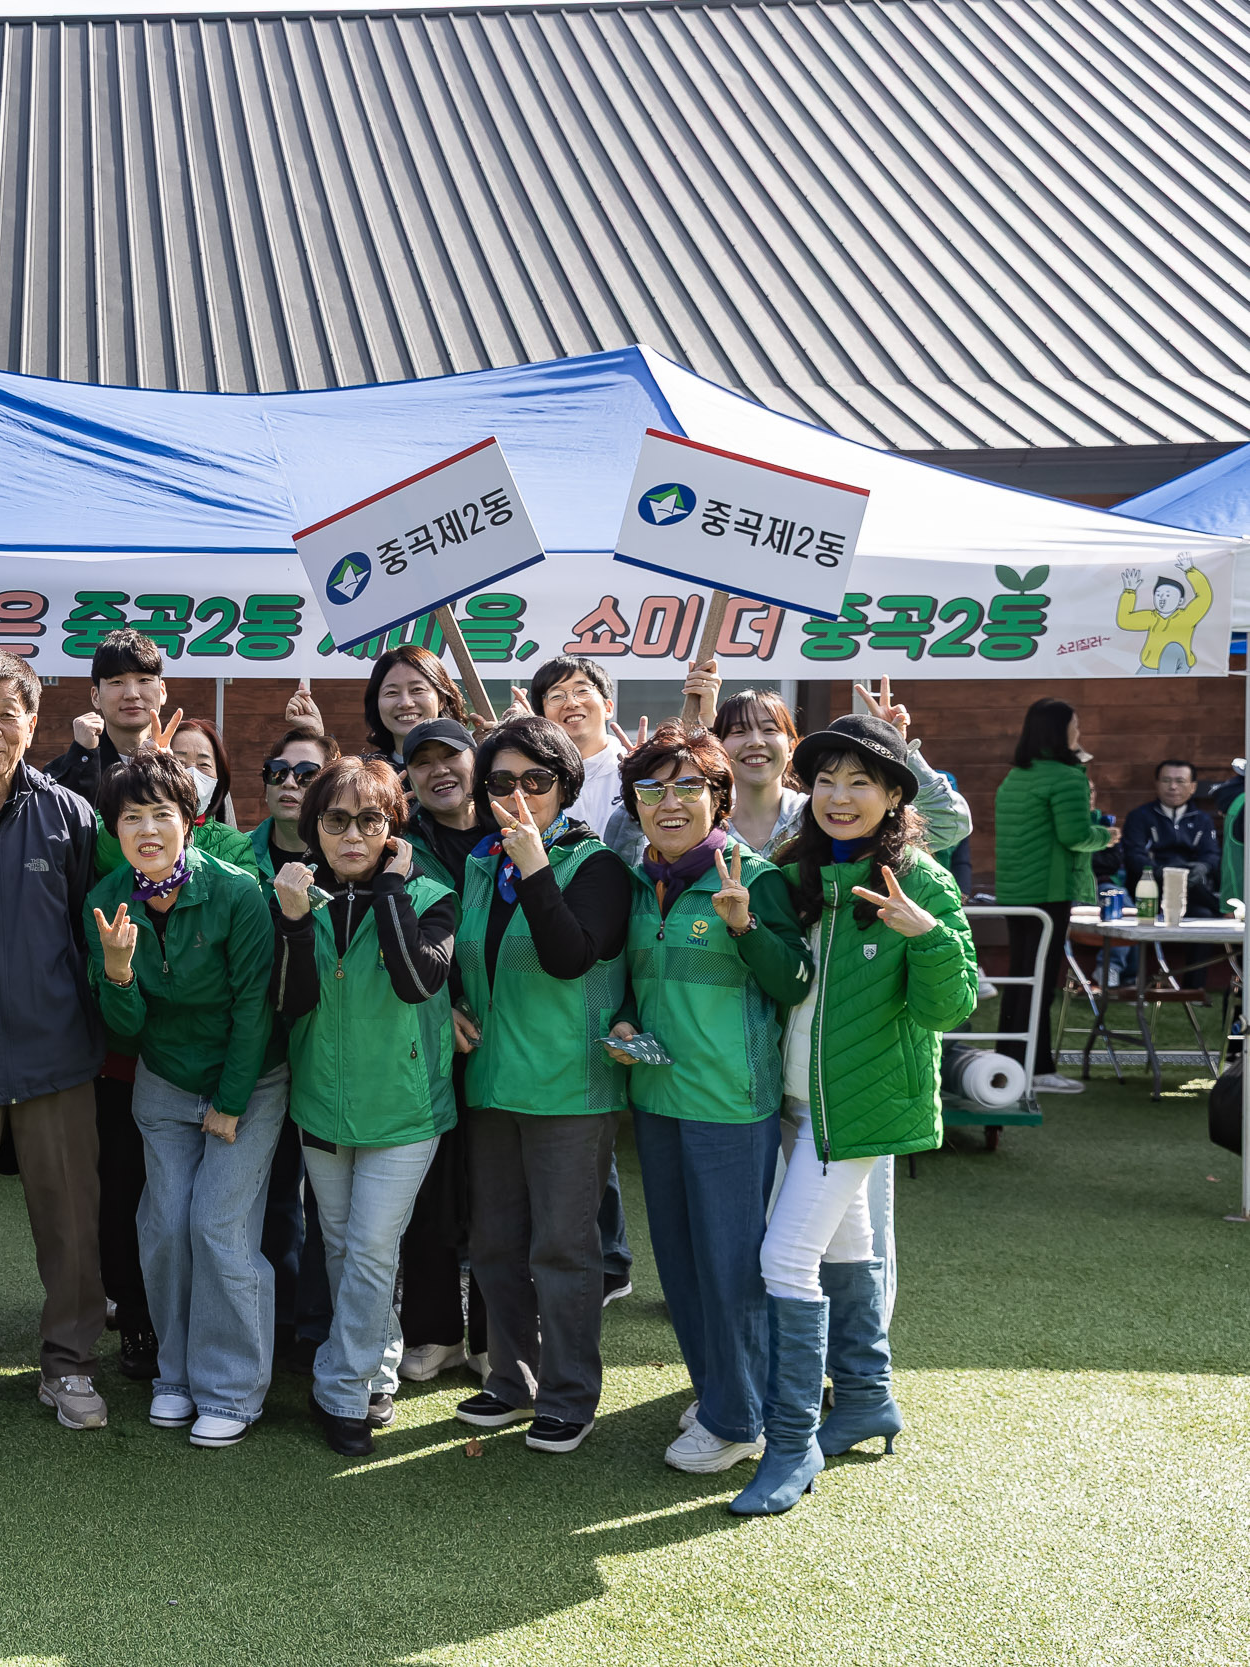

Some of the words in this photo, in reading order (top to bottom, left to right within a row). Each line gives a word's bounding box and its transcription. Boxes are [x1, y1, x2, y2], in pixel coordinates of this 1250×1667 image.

[376, 487, 515, 576] 중곡제2동
[701, 499, 846, 569] 중곡제2동
[60, 591, 306, 660] 중곡2동
[562, 594, 705, 661] 쇼미
[800, 592, 1052, 662] 중곡2동
